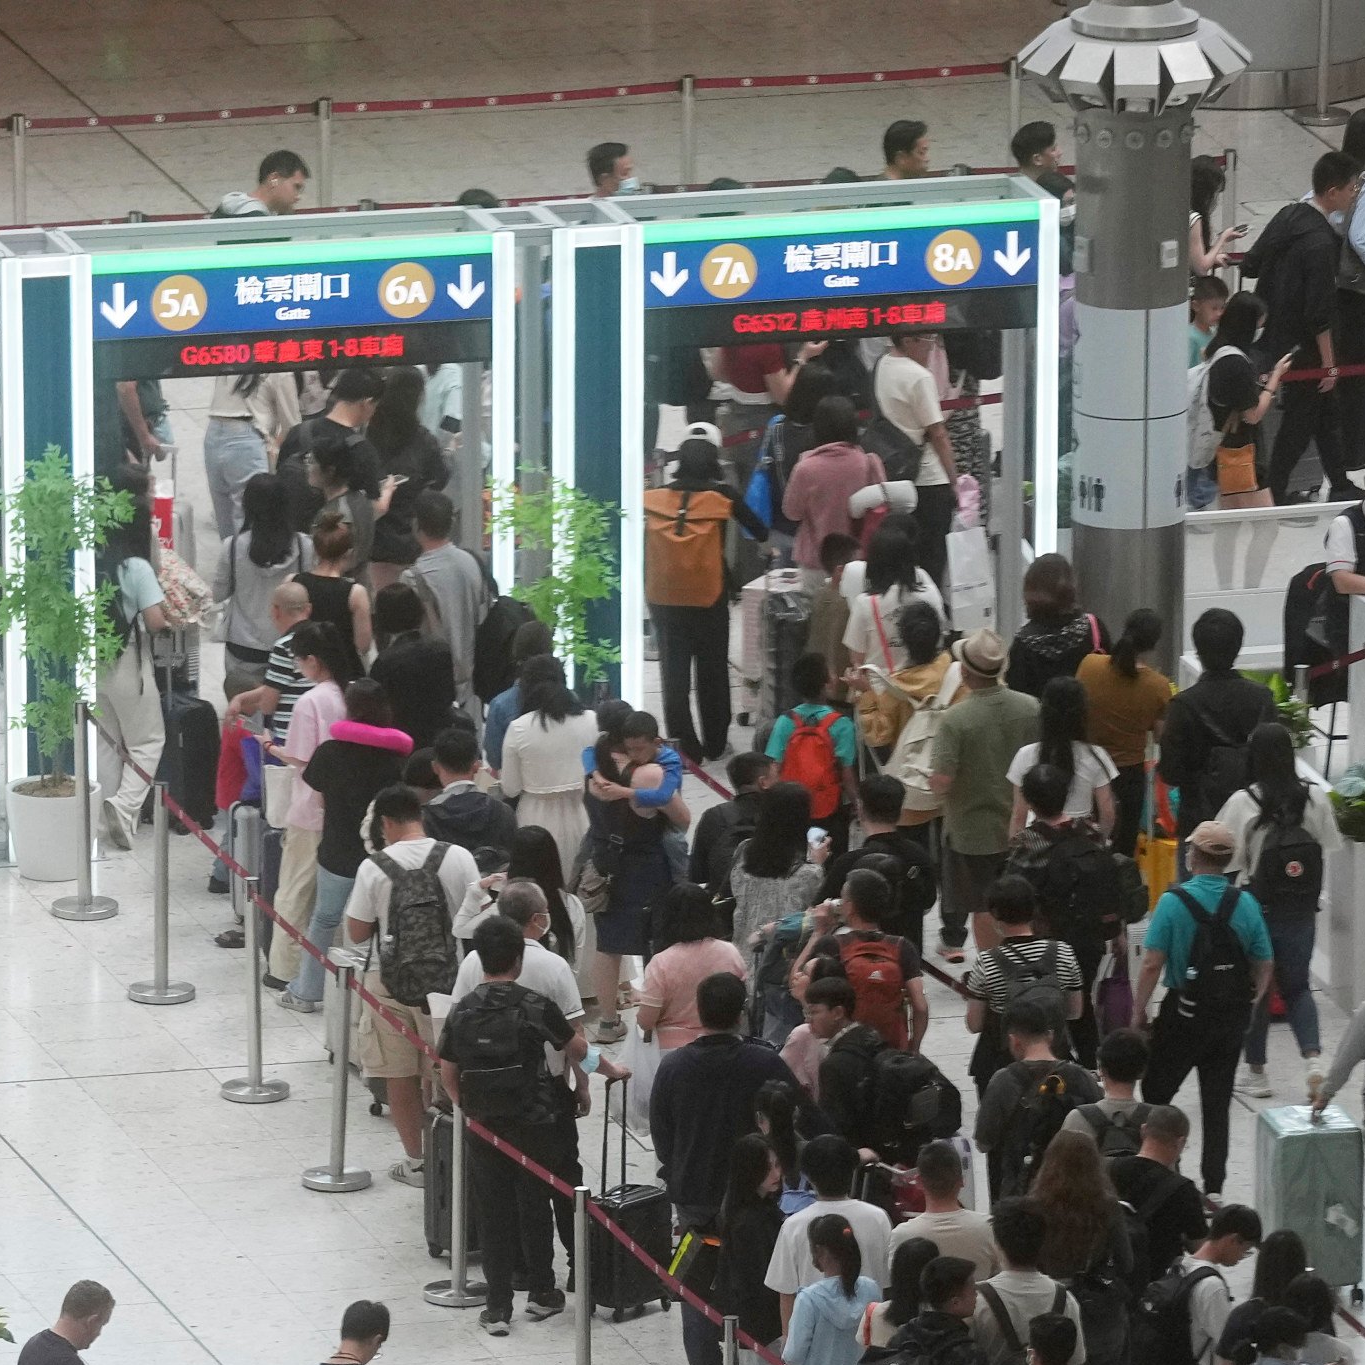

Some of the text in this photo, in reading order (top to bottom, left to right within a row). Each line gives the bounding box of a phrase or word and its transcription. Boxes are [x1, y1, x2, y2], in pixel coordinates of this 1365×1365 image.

[711, 256, 751, 287] 7A
[783, 240, 899, 273] 檢票閘口
[932, 242, 975, 273] 8A
[234, 272, 351, 305] 檢票閘口
[385, 274, 428, 306] 6A
[823, 274, 860, 288] Gate
[158, 287, 200, 319] 5A
[275, 306, 311, 321] Gate
[180, 343, 251, 366] G6580
